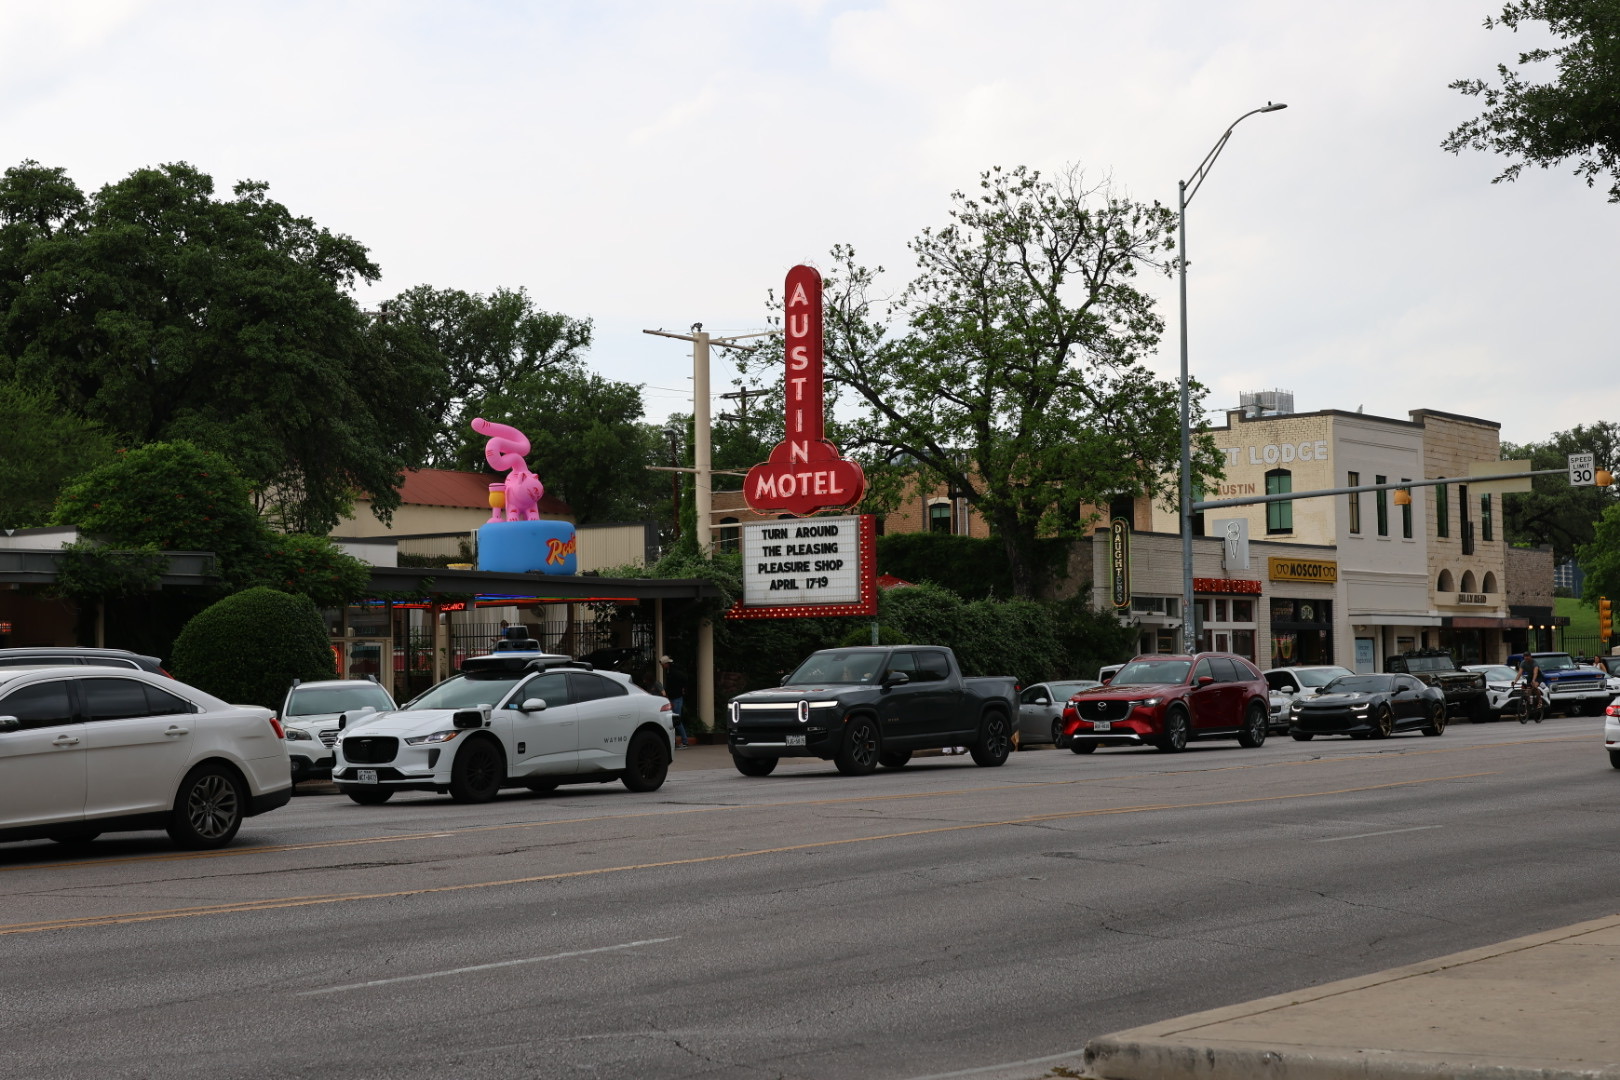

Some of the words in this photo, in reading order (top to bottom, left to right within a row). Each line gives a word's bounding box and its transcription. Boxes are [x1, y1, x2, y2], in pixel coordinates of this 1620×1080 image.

[788, 281, 810, 464] AUSTIN
[1248, 440, 1329, 465] LODGE
[1570, 456, 1593, 464] SPEED
[1573, 469, 1592, 483] 30
[754, 470, 844, 500] MOTEL
[1216, 483, 1256, 496] AUSTIN
[761, 528, 788, 540] TURN
[795, 525, 839, 538] AROUND
[762, 545, 782, 557] THE
[786, 543, 838, 556] PLEASING
[758, 560, 810, 574] PLEASURE
[814, 559, 843, 572] SHOP
[1114, 524, 1124, 603] DAUGHTERS
[1290, 563, 1322, 578] MOSCOT
[769, 579, 799, 591] APRIL
[805, 576, 828, 589] 17-19
[1459, 594, 1473, 603] BILLY
[603, 736, 628, 744] WAYMO
